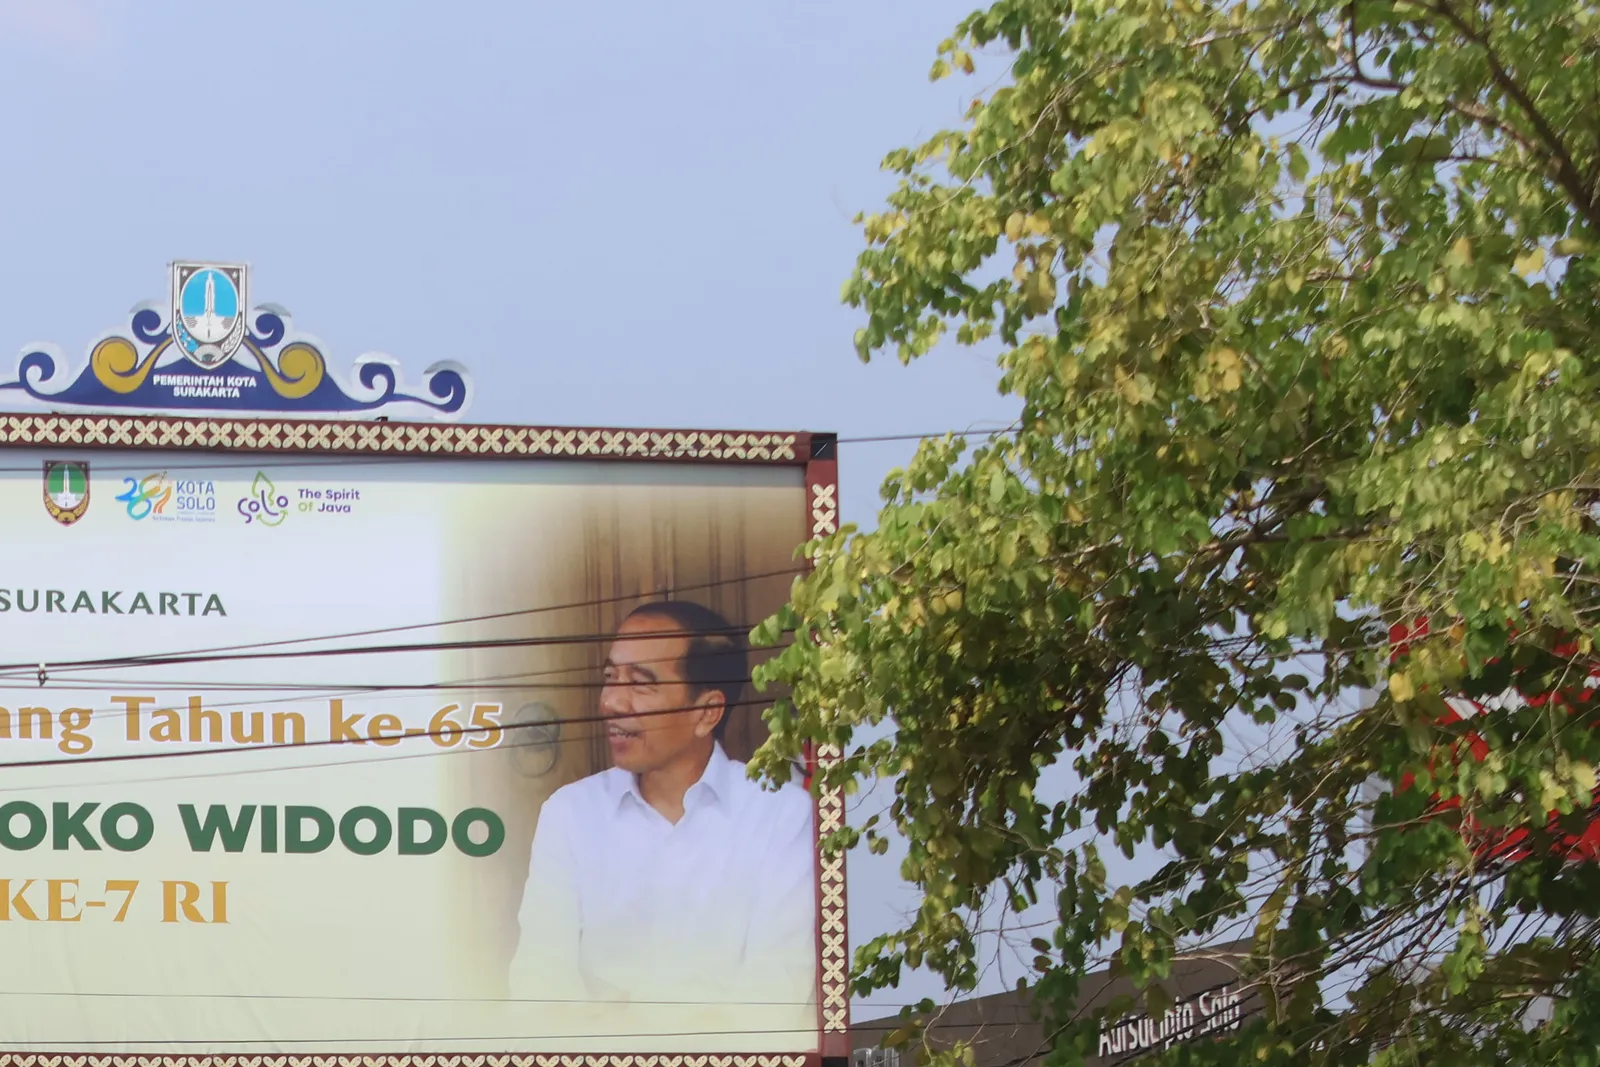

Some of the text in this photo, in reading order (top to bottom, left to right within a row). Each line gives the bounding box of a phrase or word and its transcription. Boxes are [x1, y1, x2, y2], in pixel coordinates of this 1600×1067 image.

[153, 374, 257, 388] PEMERINTAH KOTA
[173, 386, 240, 398] SURAKARTA
[176, 481, 215, 495] KOTA
[298, 489, 360, 503] The Spirit
[176, 496, 216, 511] SOLO
[298, 502, 351, 514] Of Java
[110, 694, 306, 746] Tahun
[328, 698, 503, 749] ke-65
[177, 803, 507, 858] WIDODO
[159, 880, 232, 925] RI
[1199, 986, 1242, 1035] Solo
